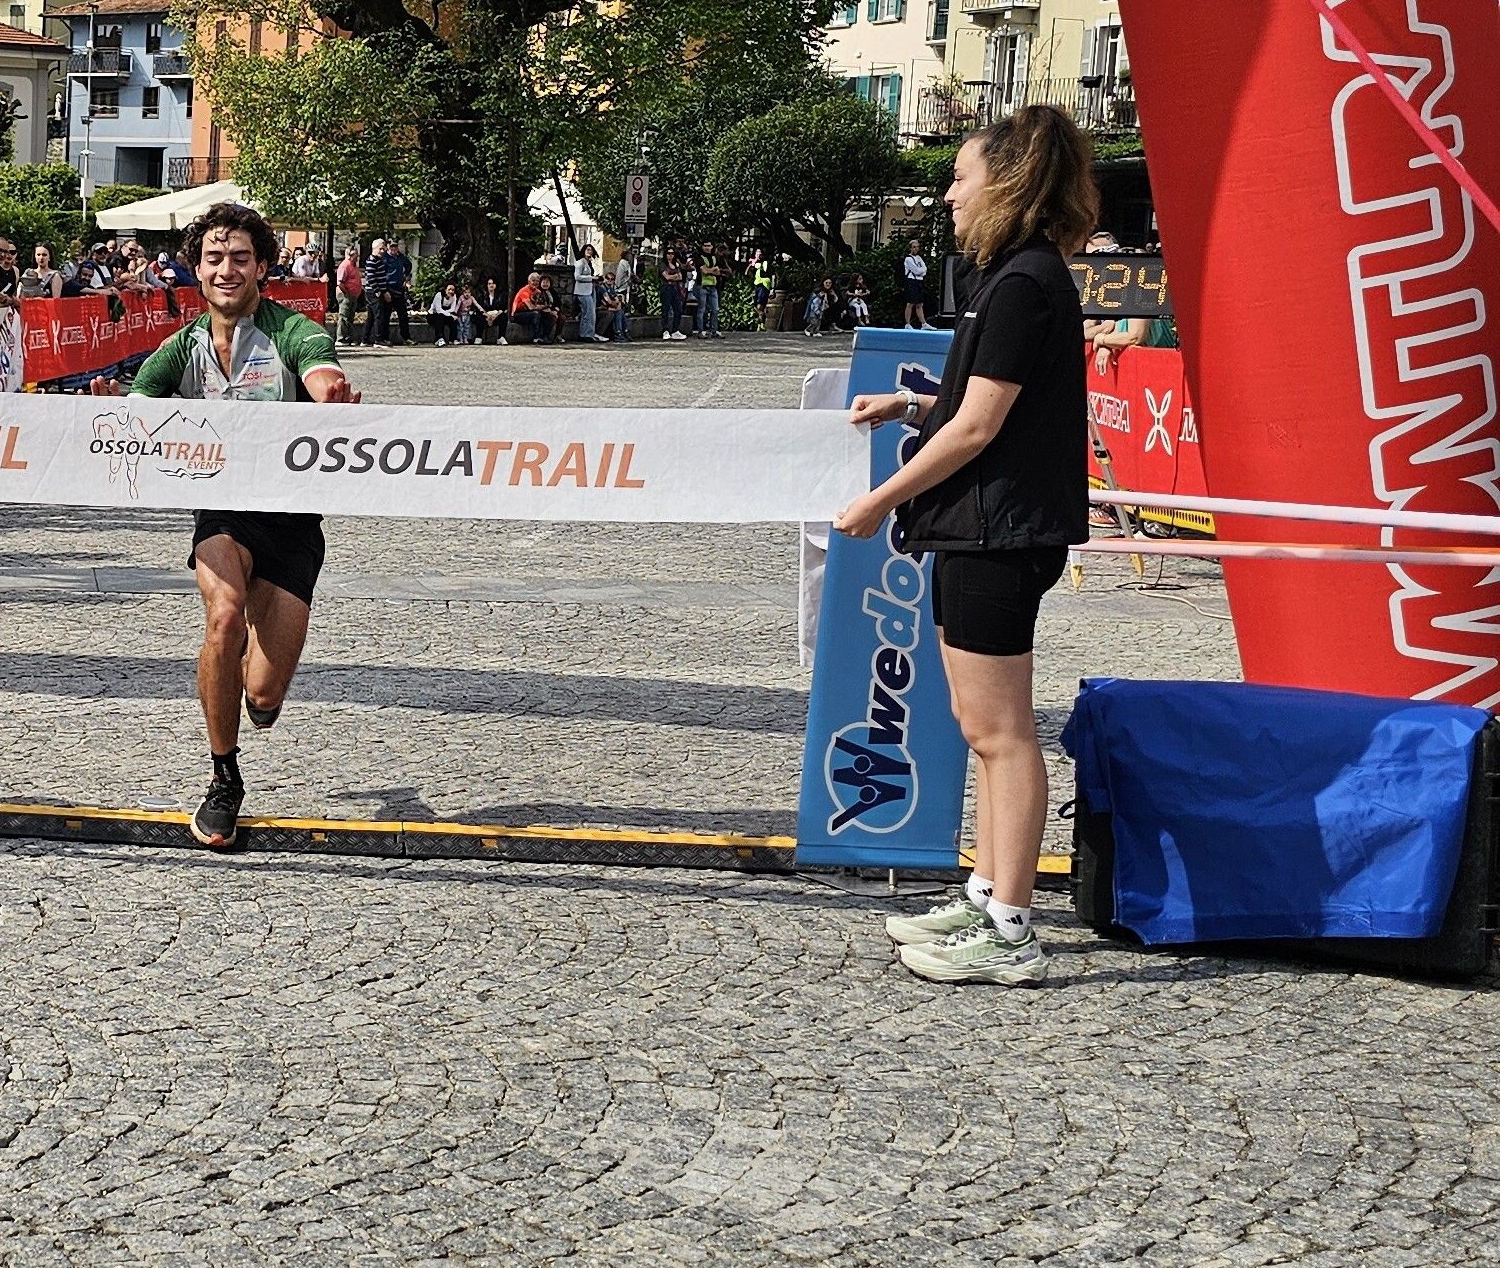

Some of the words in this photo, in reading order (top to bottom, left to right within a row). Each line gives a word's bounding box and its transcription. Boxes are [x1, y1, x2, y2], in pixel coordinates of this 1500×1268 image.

[89, 439, 227, 462] OSSOLATRAIL
[283, 435, 646, 489] OSSOLATRAIL
[187, 461, 225, 471] EVENTS
